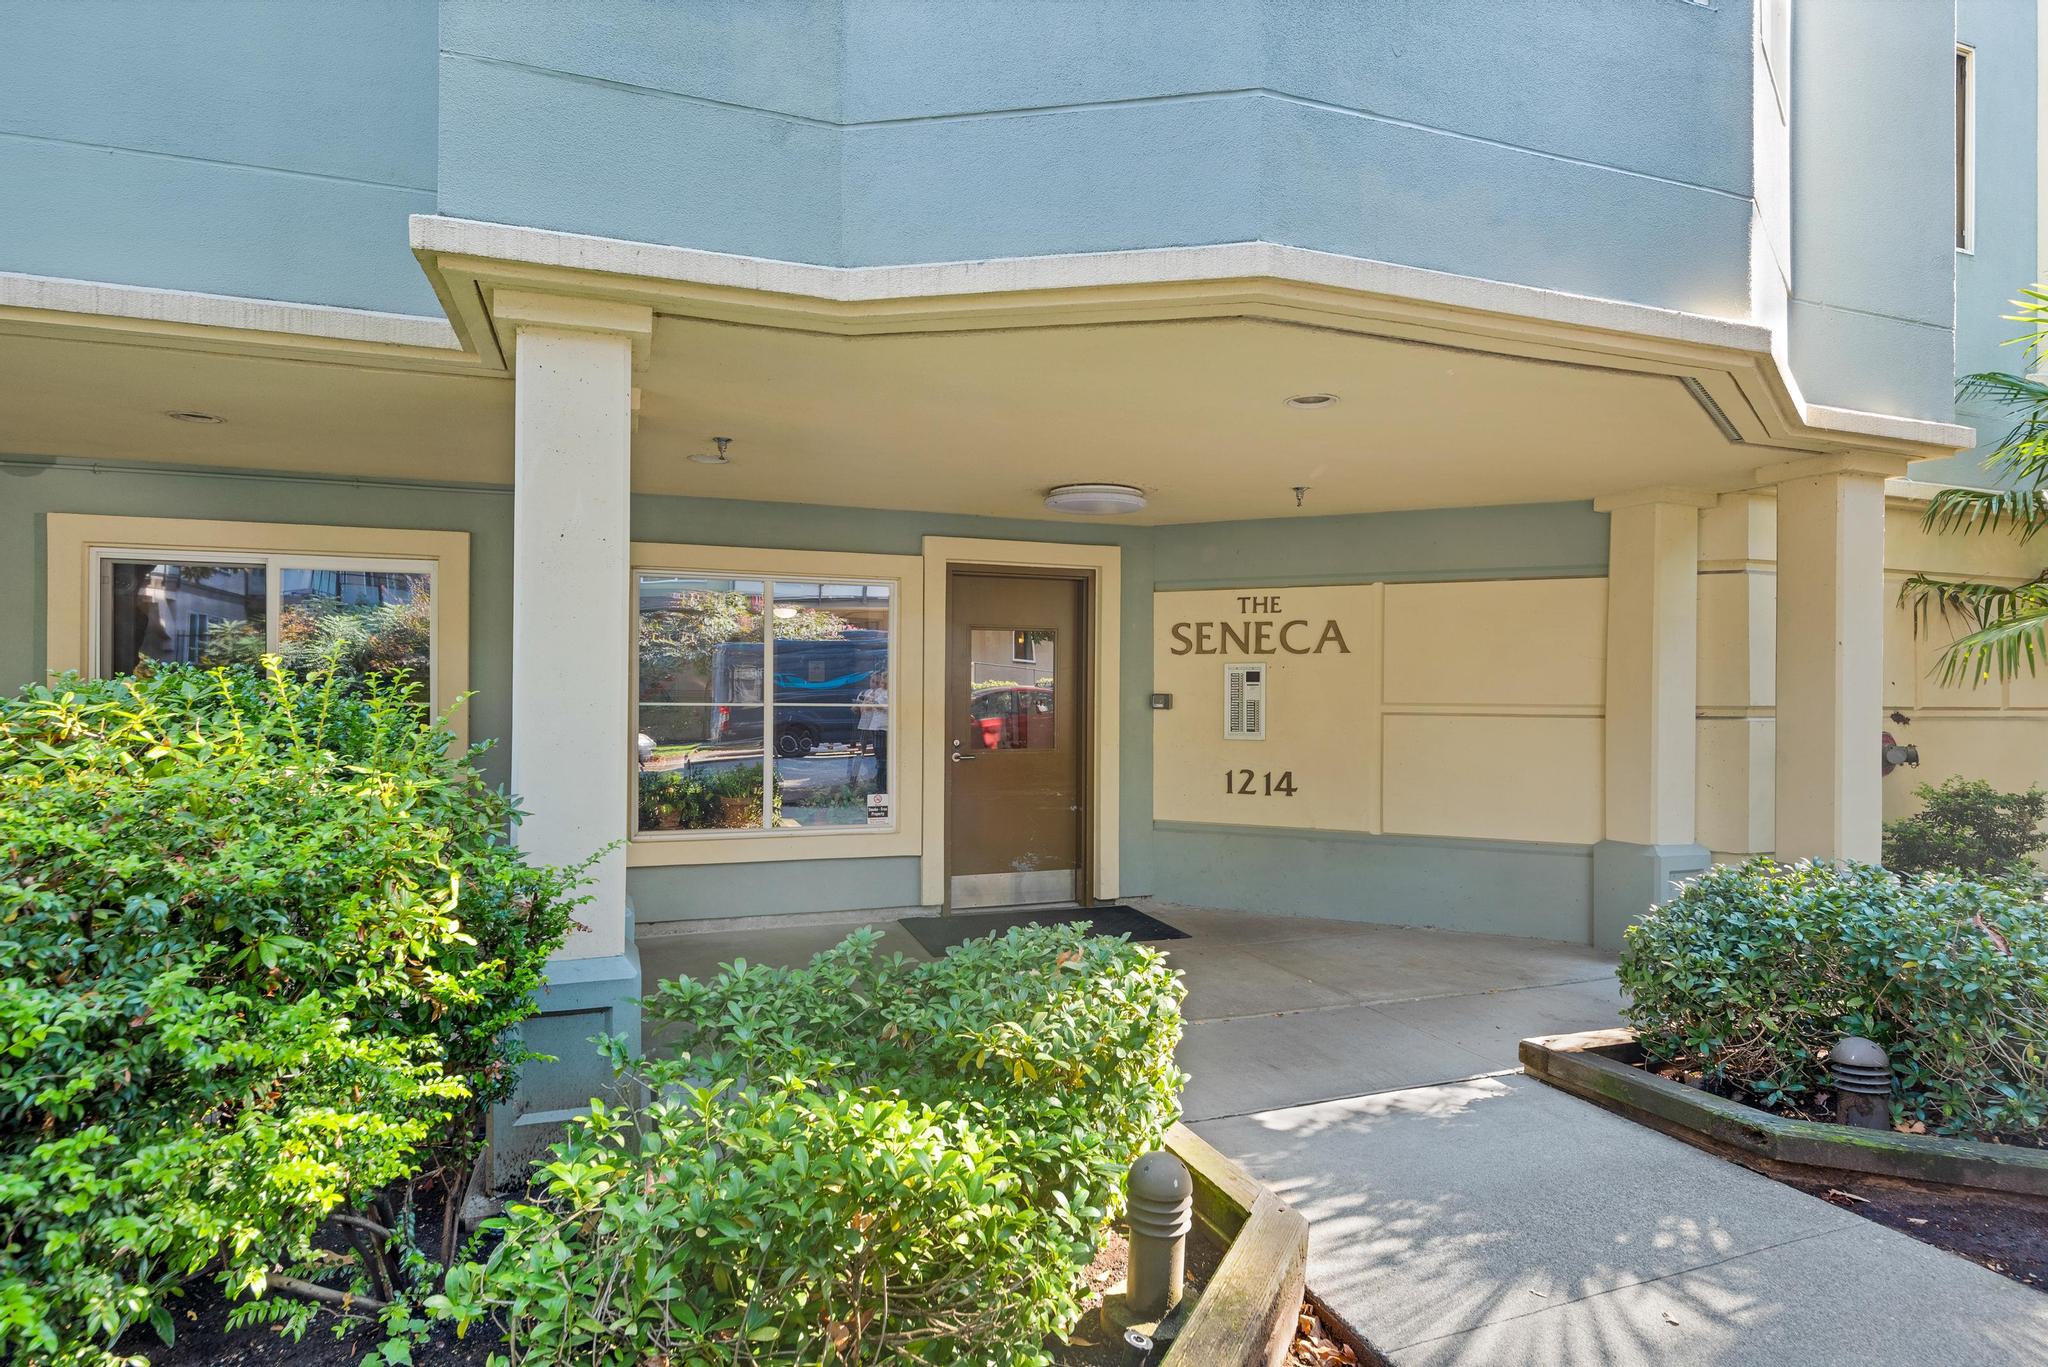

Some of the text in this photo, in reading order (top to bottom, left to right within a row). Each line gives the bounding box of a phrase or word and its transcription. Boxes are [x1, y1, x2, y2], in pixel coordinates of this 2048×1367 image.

[1237, 596, 1282, 614] THE
[1170, 620, 1351, 655] SENECA
[1225, 769, 1298, 796] 1214
